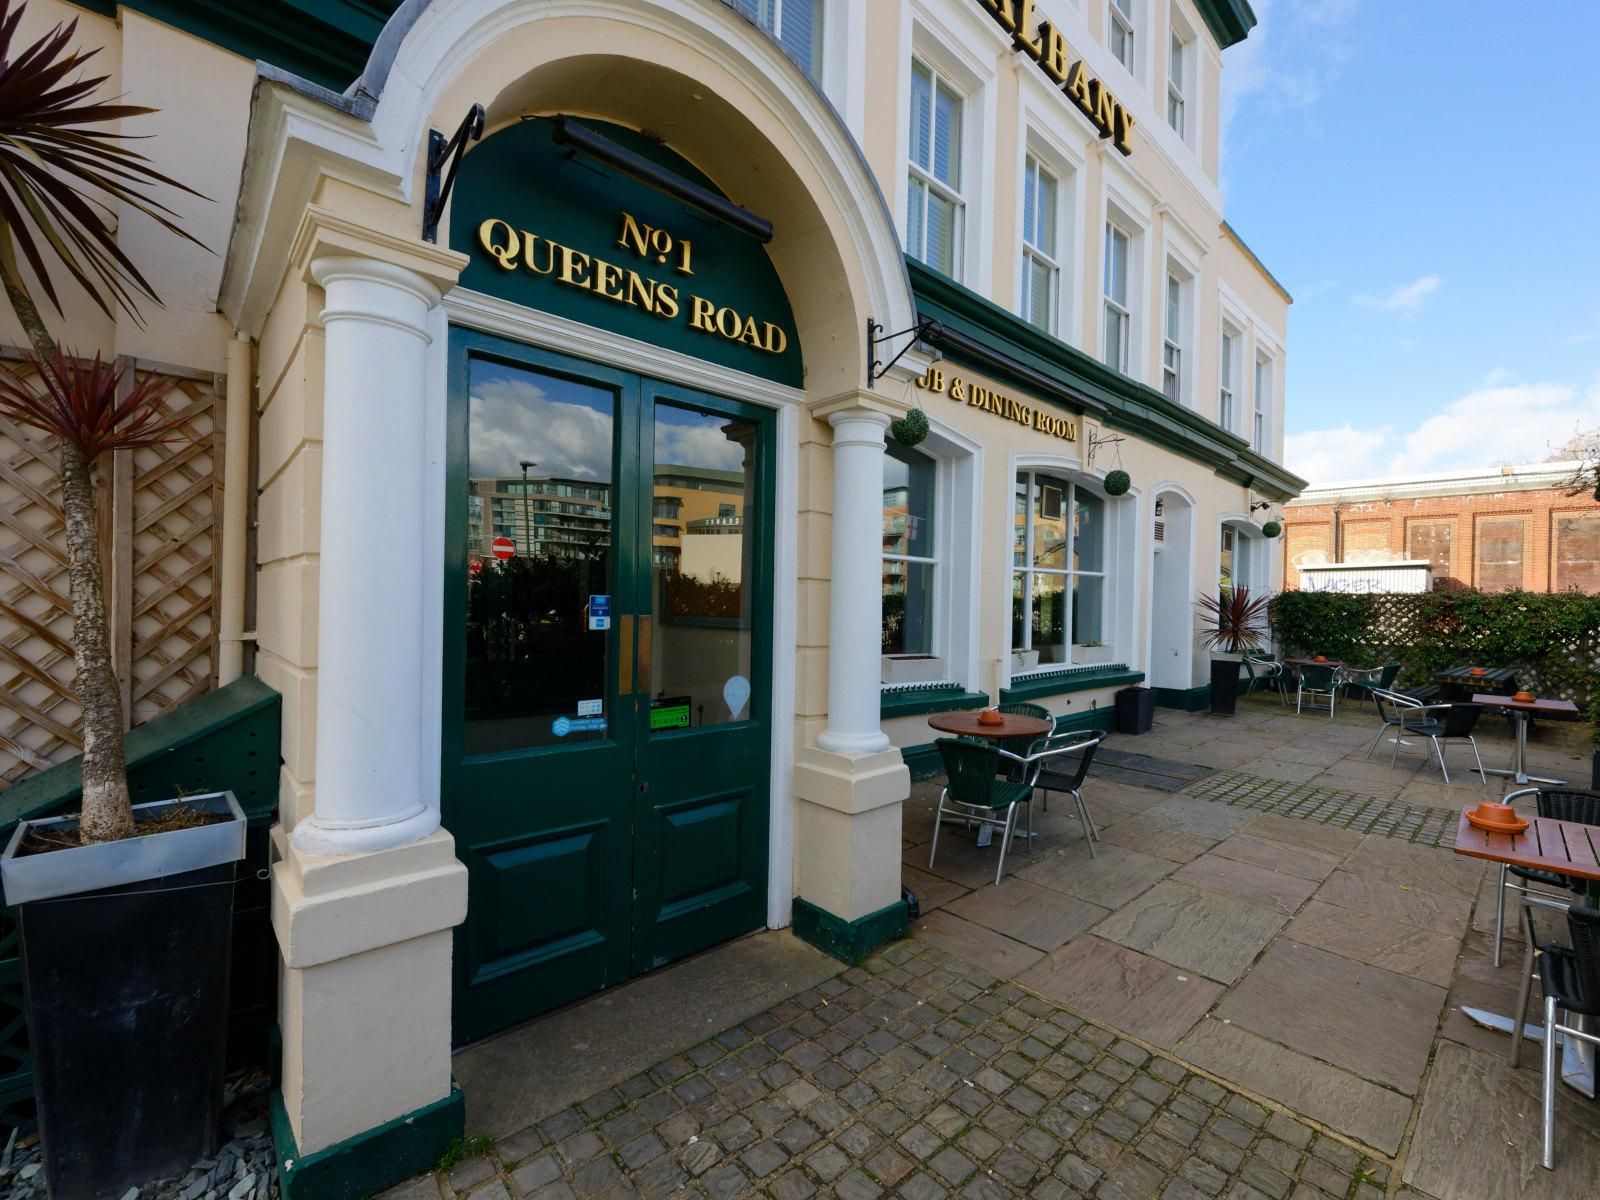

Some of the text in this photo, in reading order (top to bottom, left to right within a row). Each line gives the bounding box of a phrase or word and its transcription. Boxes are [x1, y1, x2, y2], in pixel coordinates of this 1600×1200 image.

[477, 218, 788, 353] QUEENS ROAD
[949, 377, 965, 401] &
[968, 383, 1032, 426] DINING
[1033, 409, 1078, 442] ROOM
